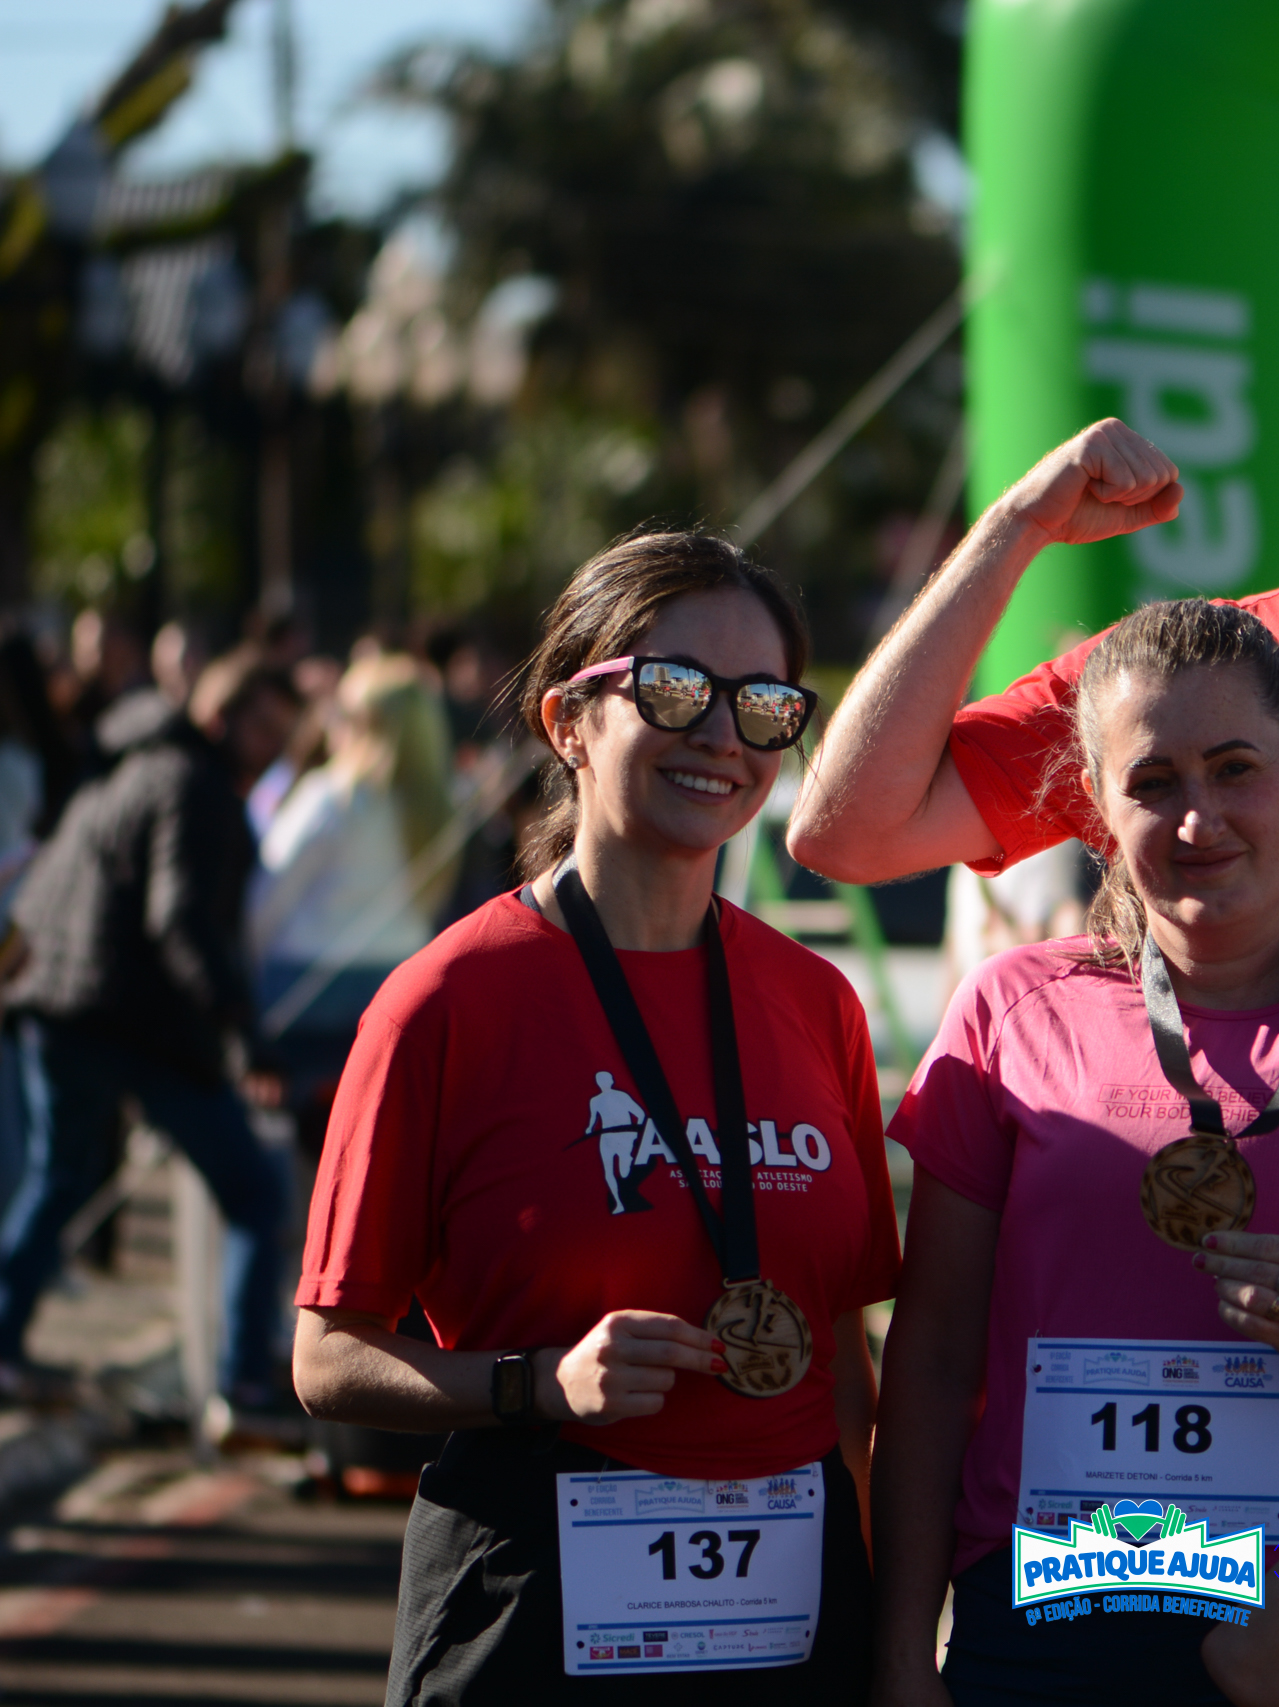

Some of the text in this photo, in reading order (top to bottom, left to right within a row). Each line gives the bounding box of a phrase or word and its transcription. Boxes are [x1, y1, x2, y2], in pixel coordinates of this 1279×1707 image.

[1111, 1088, 1123, 1100] IF
[1128, 1089, 1171, 1101] YOUR
[1105, 1104, 1151, 1119] YOUR
[1155, 1106, 1191, 1119] BOD
[756, 1172, 813, 1183] ATLETISMO
[759, 1181, 773, 1190] DO
[777, 1182, 808, 1192] OESTE
[1086, 1367, 1147, 1378] PRATIQUE AJUDA
[1162, 1367, 1182, 1379] ONG
[1224, 1376, 1265, 1388] CAUSA
[1091, 1402, 1212, 1454] 118
[1085, 1471, 1125, 1480] MARIZETE
[1127, 1472, 1158, 1481] DETONI
[1165, 1473, 1193, 1482] Corrida
[1194, 1474, 1199, 1482] 5
[1201, 1474, 1213, 1482] km
[638, 1496, 703, 1508] PRATIQUE AJUDA
[716, 1494, 735, 1505] ONG
[767, 1498, 797, 1510] CAUSA
[1046, 1499, 1073, 1510] Sicredi
[584, 1507, 624, 1517] BENEFICENTE
[648, 1528, 761, 1580] 137
[627, 1600, 662, 1610] CLARICE
[664, 1599, 702, 1610] BARBOSA
[703, 1598, 735, 1608] CHALITO
[740, 1597, 763, 1607] Corrida
[763, 1597, 768, 1605] 5
[769, 1597, 778, 1605] km
[602, 1632, 635, 1643] Sicredi
[680, 1631, 705, 1640] CRESOL
